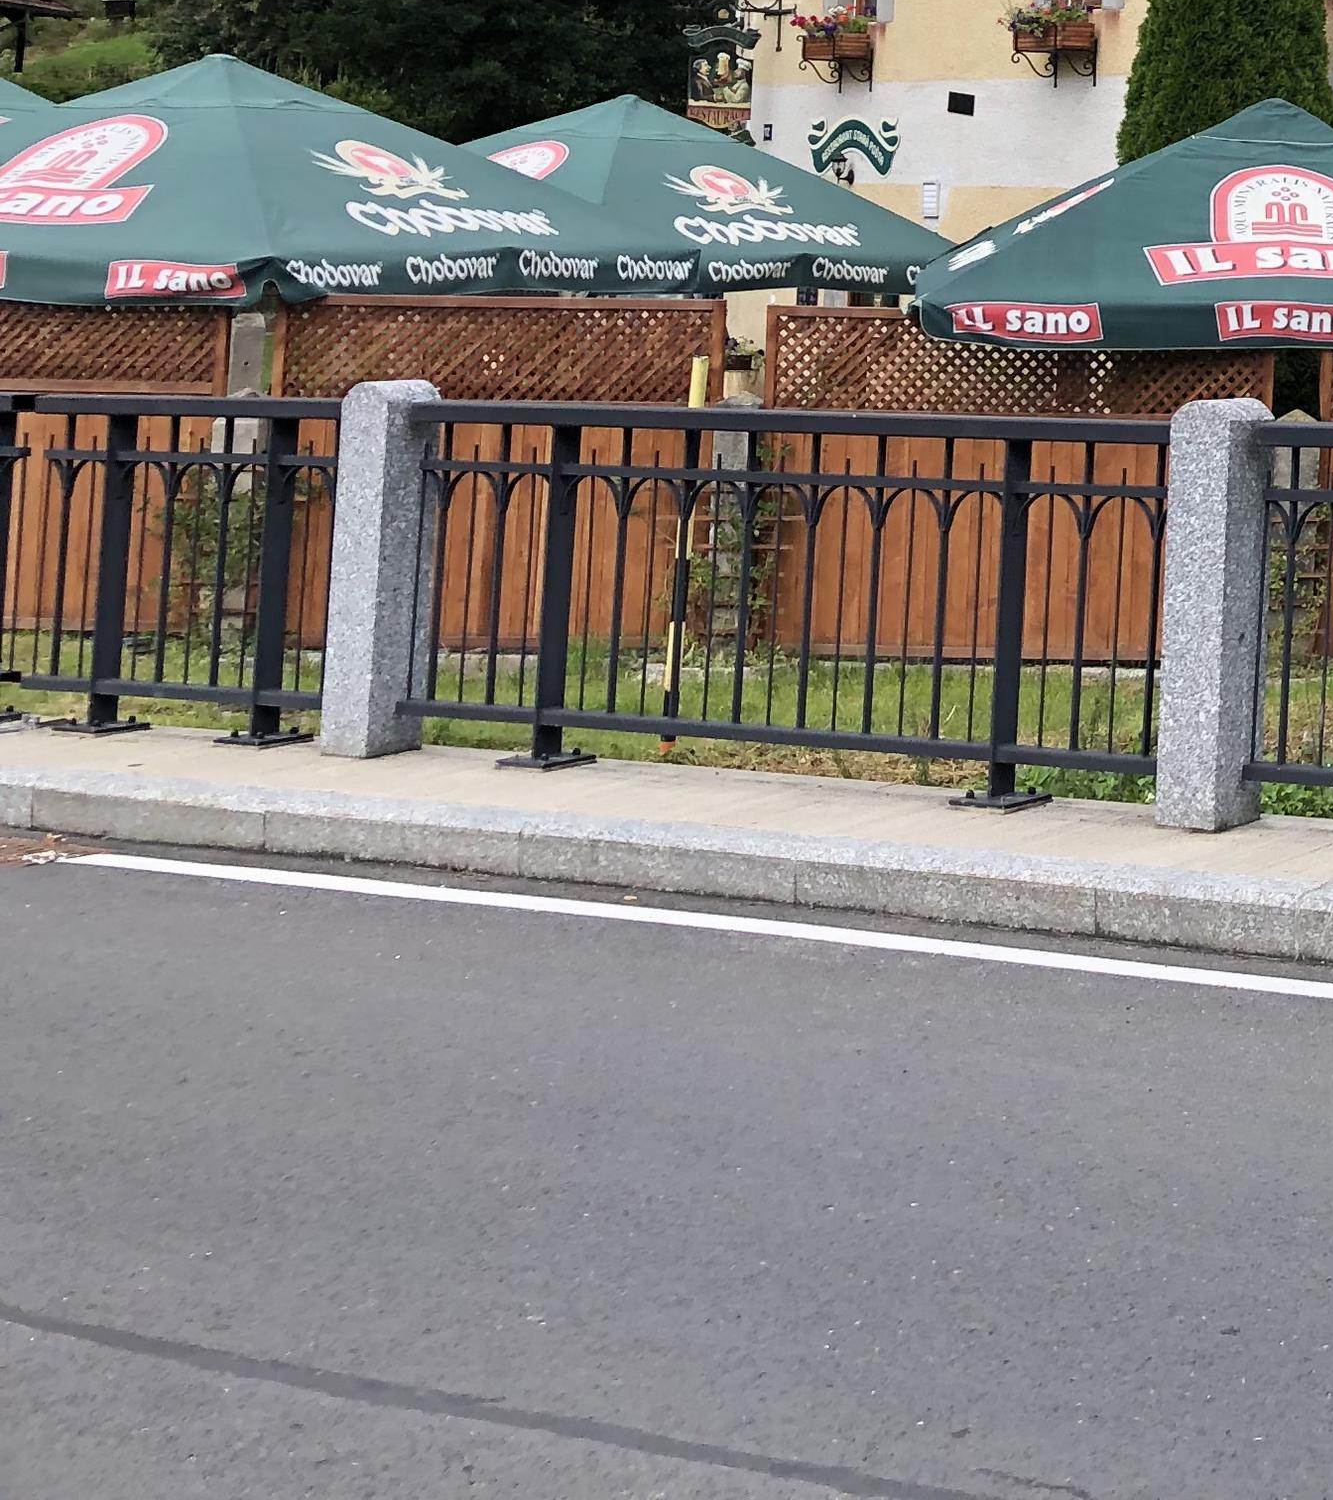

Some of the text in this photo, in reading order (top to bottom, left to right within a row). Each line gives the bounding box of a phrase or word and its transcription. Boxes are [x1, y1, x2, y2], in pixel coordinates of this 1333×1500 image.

[0, 192, 126, 218] ano
[1233, 176, 1309, 208] MINERALIS
[1162, 246, 1235, 277] IL
[114, 263, 233, 292] IL sano
[1005, 309, 1091, 335] sano
[1226, 303, 1262, 332] IL
